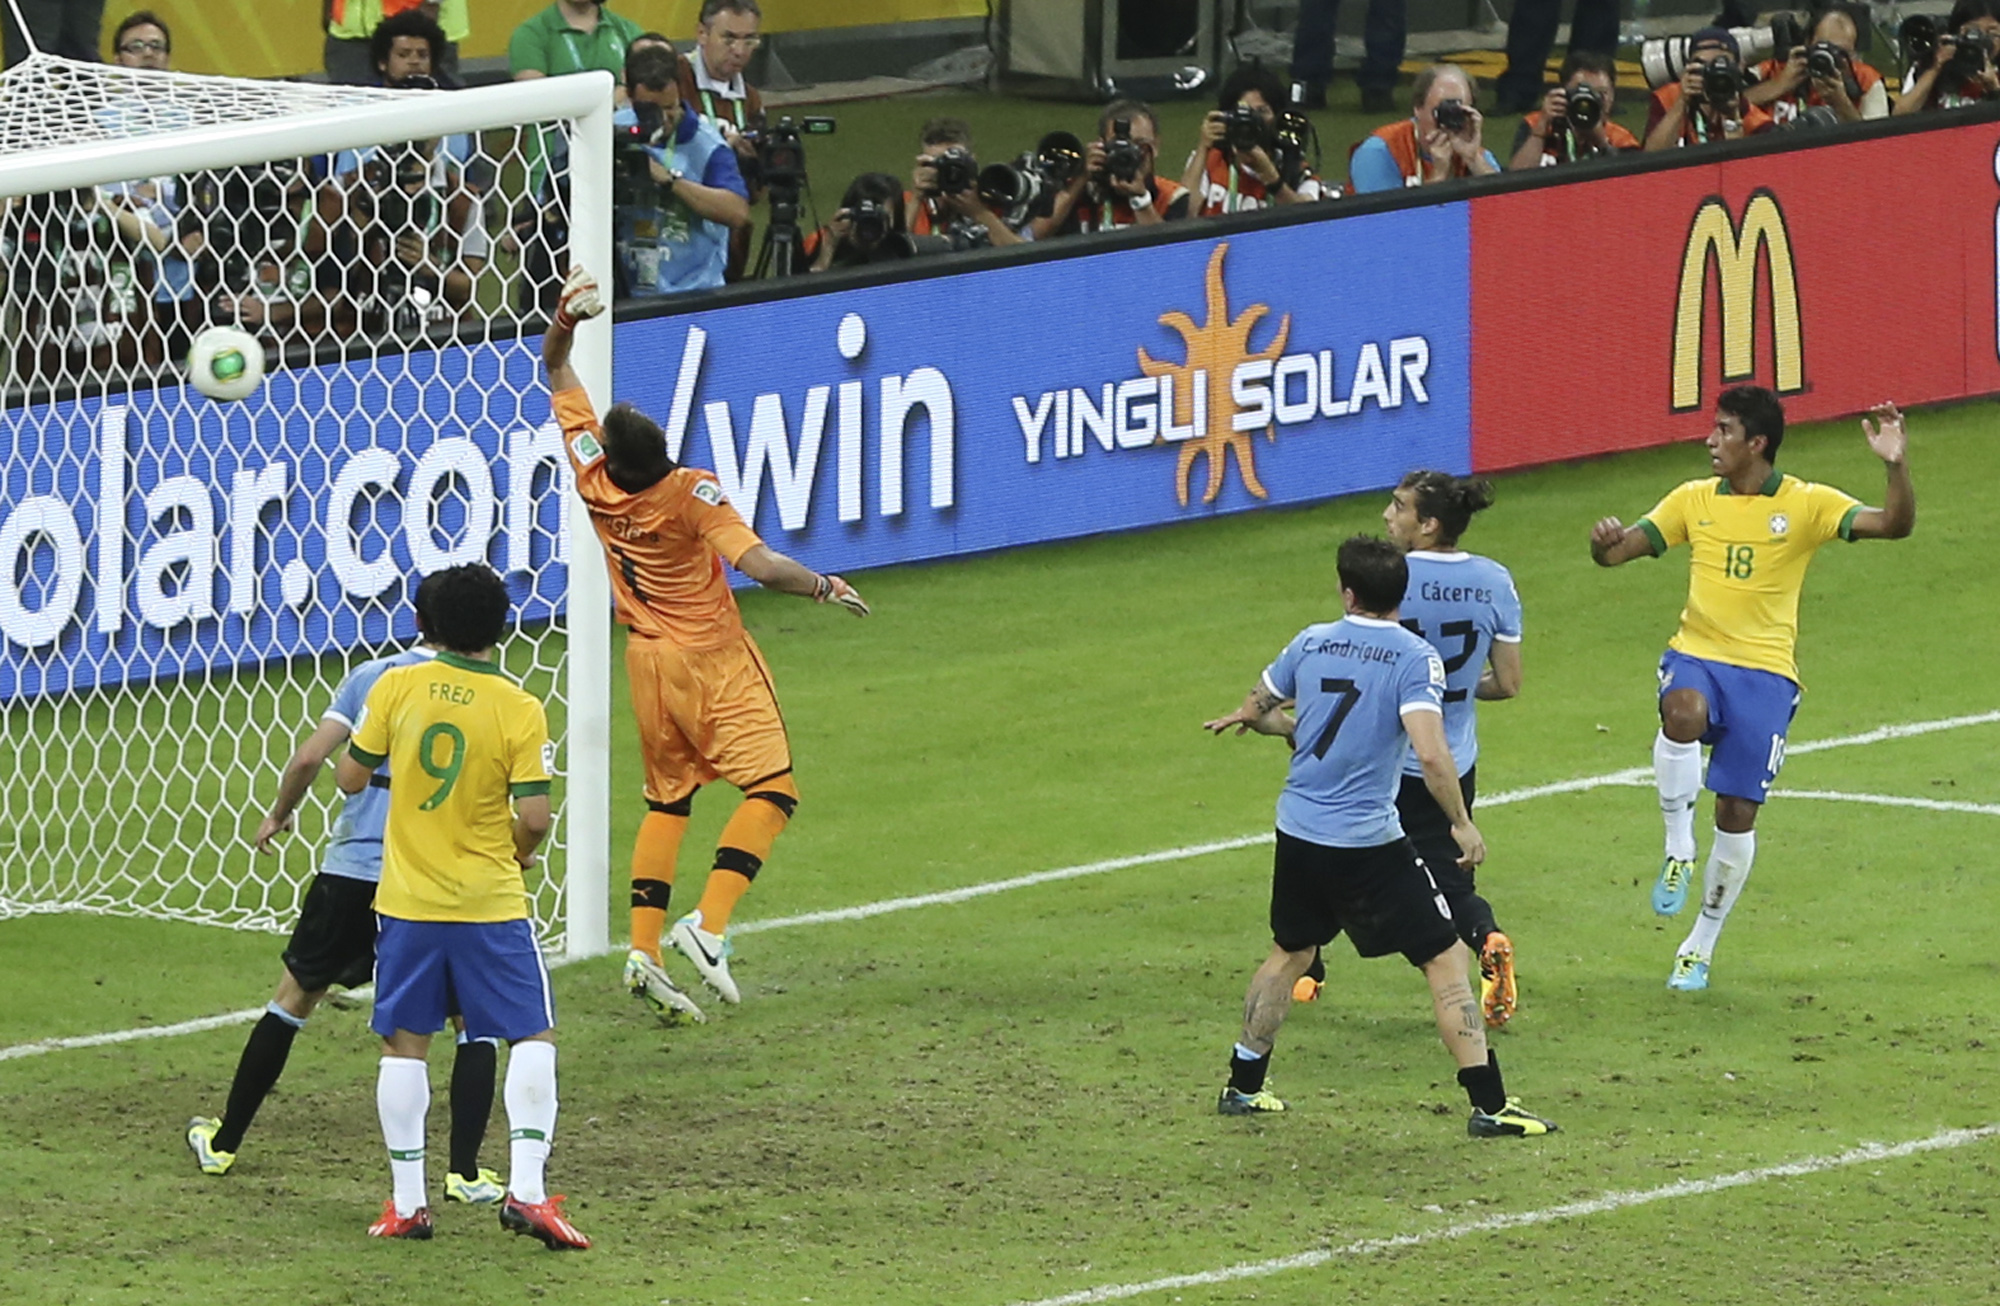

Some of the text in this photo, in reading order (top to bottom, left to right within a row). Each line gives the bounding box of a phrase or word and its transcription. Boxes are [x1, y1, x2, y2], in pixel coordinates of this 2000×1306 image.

[1012, 336, 1431, 464] YINGLI SOLAR
[1725, 544, 1754, 579] 18
[1421, 580, 1494, 605] Cáceres
[428, 681, 476, 706] FRED
[1311, 677, 1362, 761] 7
[418, 721, 467, 812] 9
